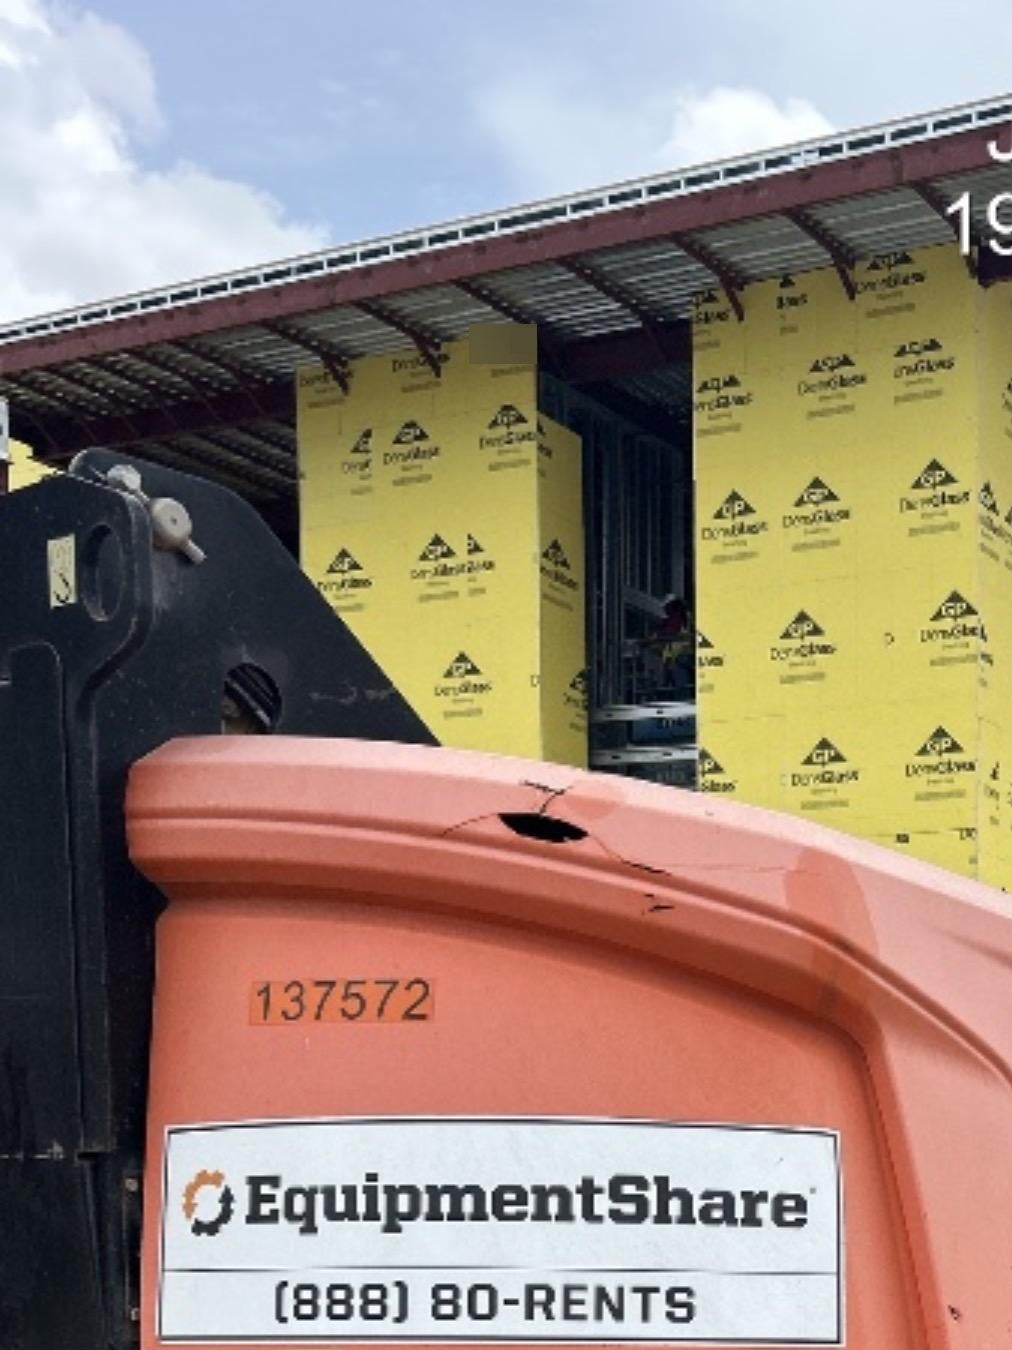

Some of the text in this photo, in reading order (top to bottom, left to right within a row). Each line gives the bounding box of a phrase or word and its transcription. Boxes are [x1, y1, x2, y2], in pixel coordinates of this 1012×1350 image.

[254, 976, 432, 1023] 137572
[245, 1172, 810, 1234] EquipmentShare
[273, 1281, 697, 1324] (888) 80-RENTS
